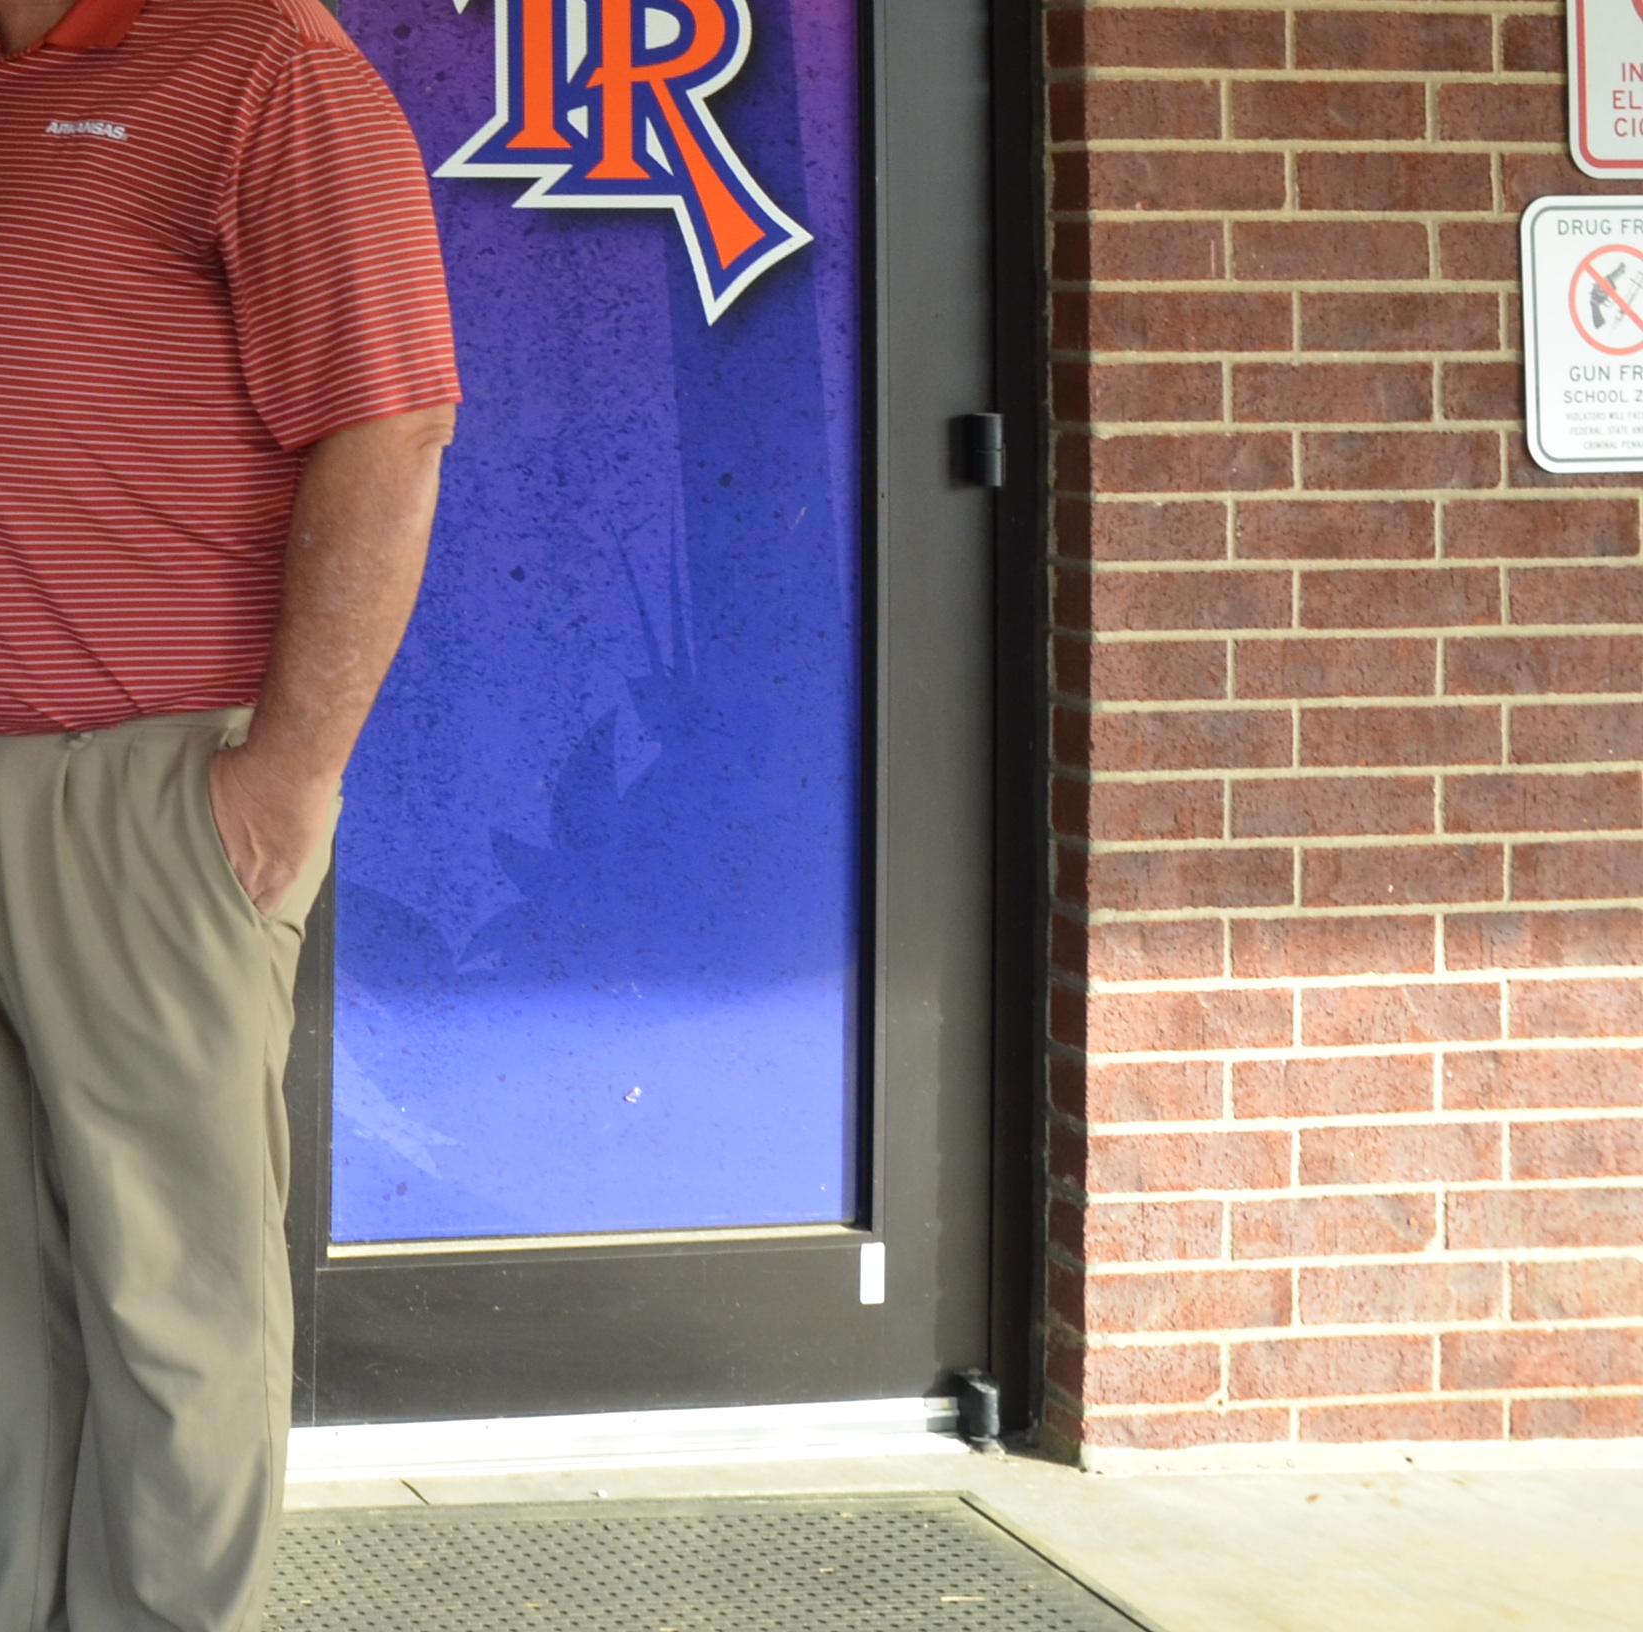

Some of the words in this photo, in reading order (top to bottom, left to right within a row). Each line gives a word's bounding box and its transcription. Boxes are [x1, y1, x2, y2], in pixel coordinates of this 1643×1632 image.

[45, 121, 125, 141] ARKANSAS
[1557, 219, 1612, 236] DRUG
[1620, 218, 1643, 235] FR
[1569, 365, 1611, 382] GUN
[1619, 364, 1643, 381] FR
[1563, 389, 1629, 404] SCHOOL
